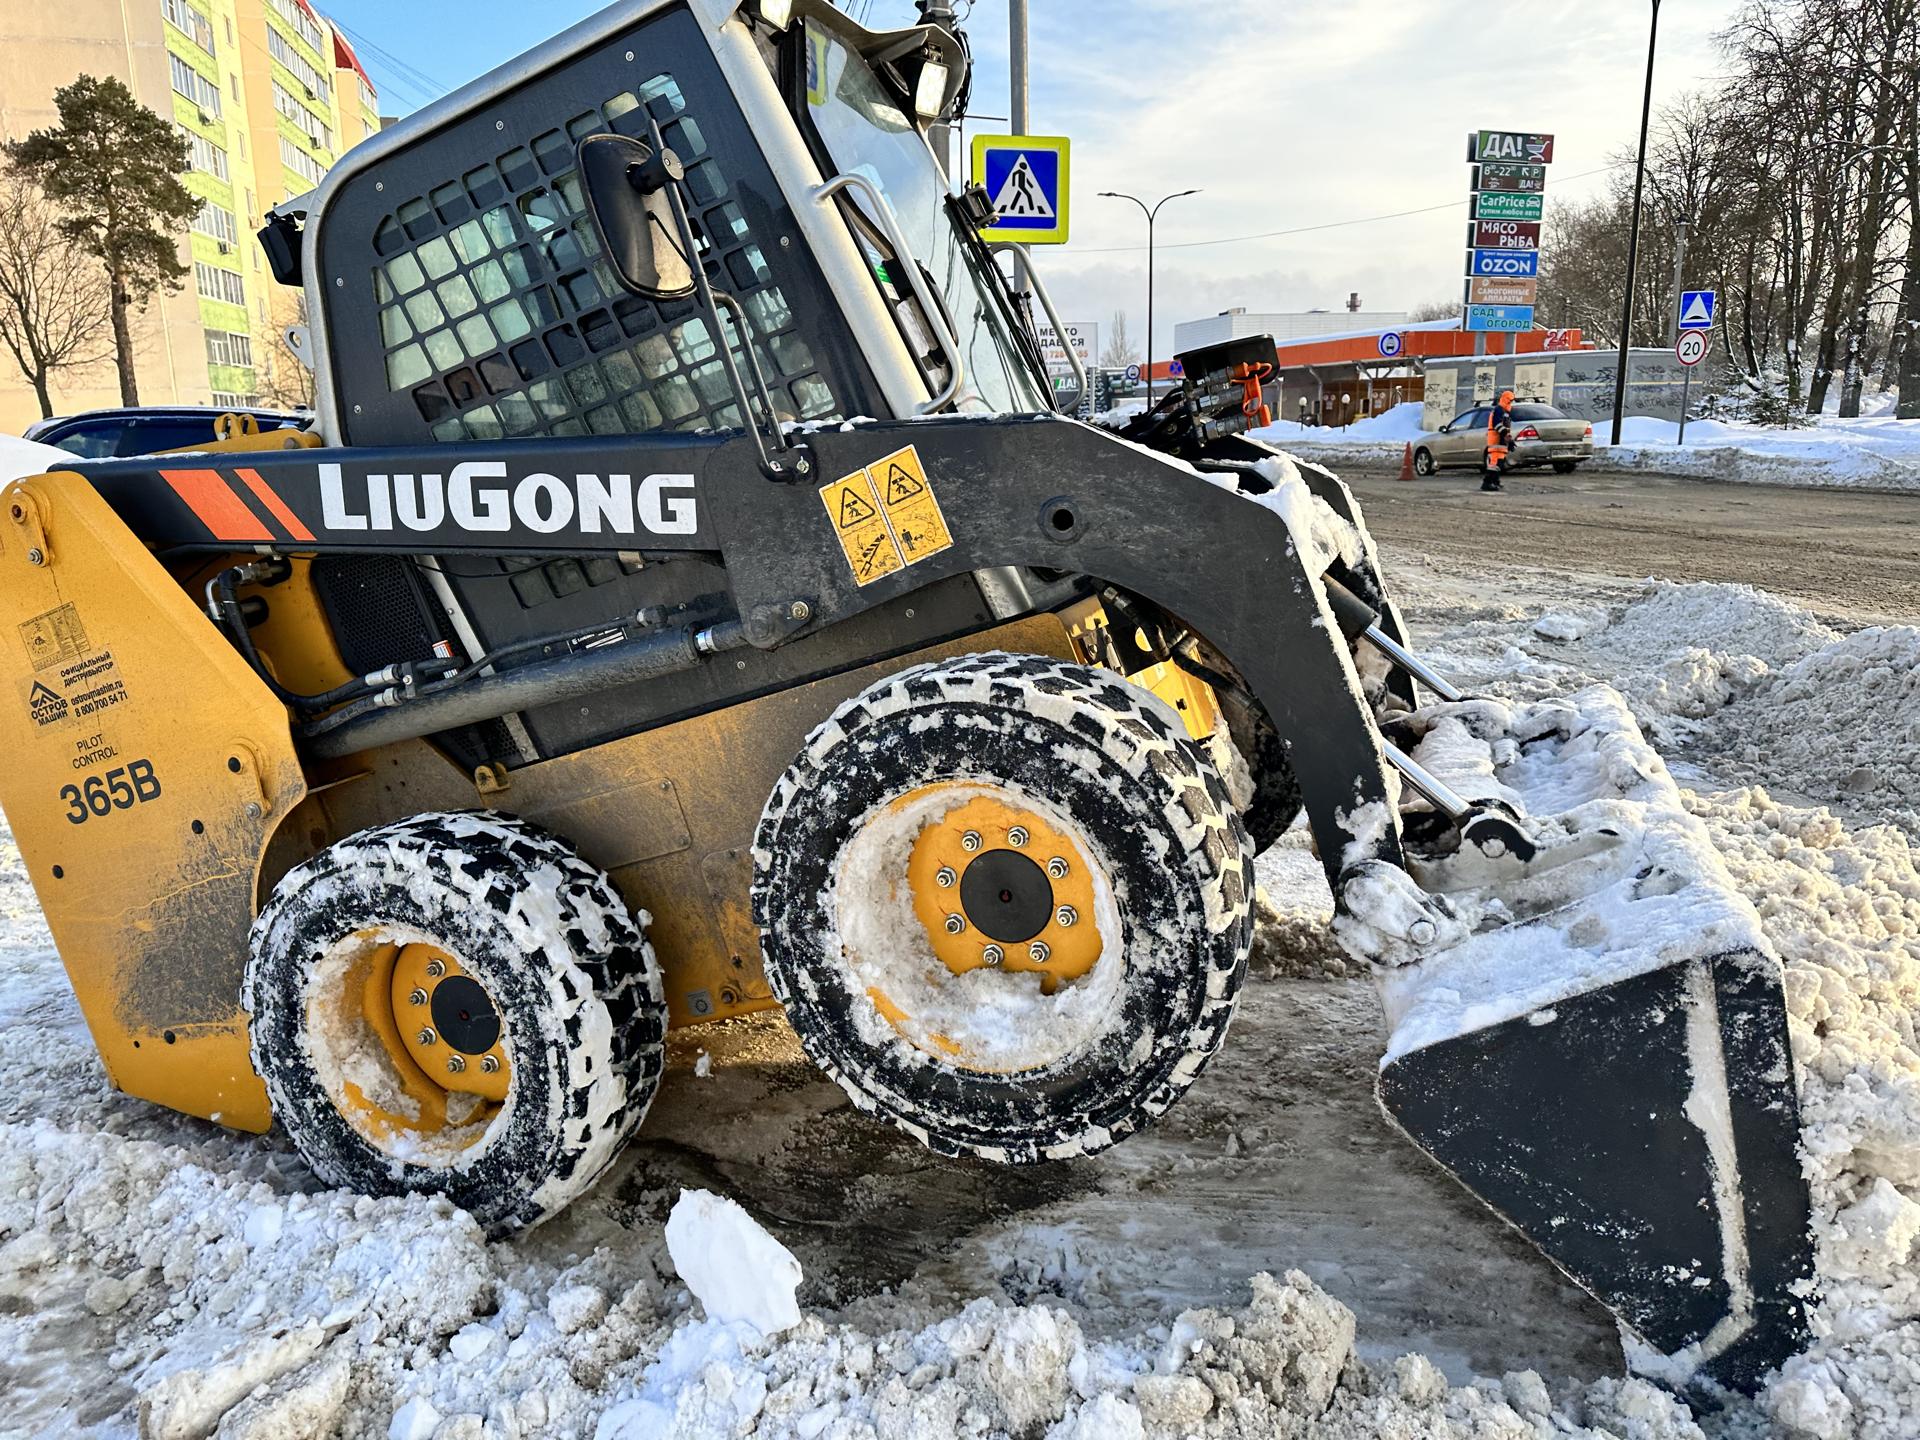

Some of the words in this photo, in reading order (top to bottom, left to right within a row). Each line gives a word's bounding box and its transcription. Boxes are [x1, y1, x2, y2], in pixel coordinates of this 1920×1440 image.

[1482, 134, 1523, 159] ДА!
[1519, 179, 1534, 189] ДА!
[1480, 195, 1526, 208] CarPrice
[1481, 222, 1518, 234] МЯСО
[1500, 235, 1535, 248] РЫБА
[1481, 258, 1531, 273] OZON
[1477, 287, 1530, 296] САМОГОННЫЕ
[1482, 295, 1523, 303] АППАРАТЫ
[1472, 307, 1494, 317] САД
[1040, 328, 1078, 336] МЕТО
[1487, 319, 1530, 330] ОГОРОД
[1547, 330, 1568, 346] 24
[1683, 341, 1700, 356] 20
[1057, 377, 1077, 390] ДА!
[60, 650, 112, 678] ОФИЦИАЛЬНЫЙ
[63, 661, 114, 688] ДИСТРИБЬЮТОР
[70, 679, 124, 706] ostrovmashin.ru
[31, 698, 69, 720] ОСТРОВ
[74, 707, 81, 718] 8
[81, 702, 95, 716] 800
[109, 693, 119, 705] 54
[118, 690, 129, 702] 71
[37, 708, 69, 727] МАШИН
[76, 733, 104, 753] PILOT
[72, 745, 118, 770] CONTROL
[60, 758, 162, 825] 365B
